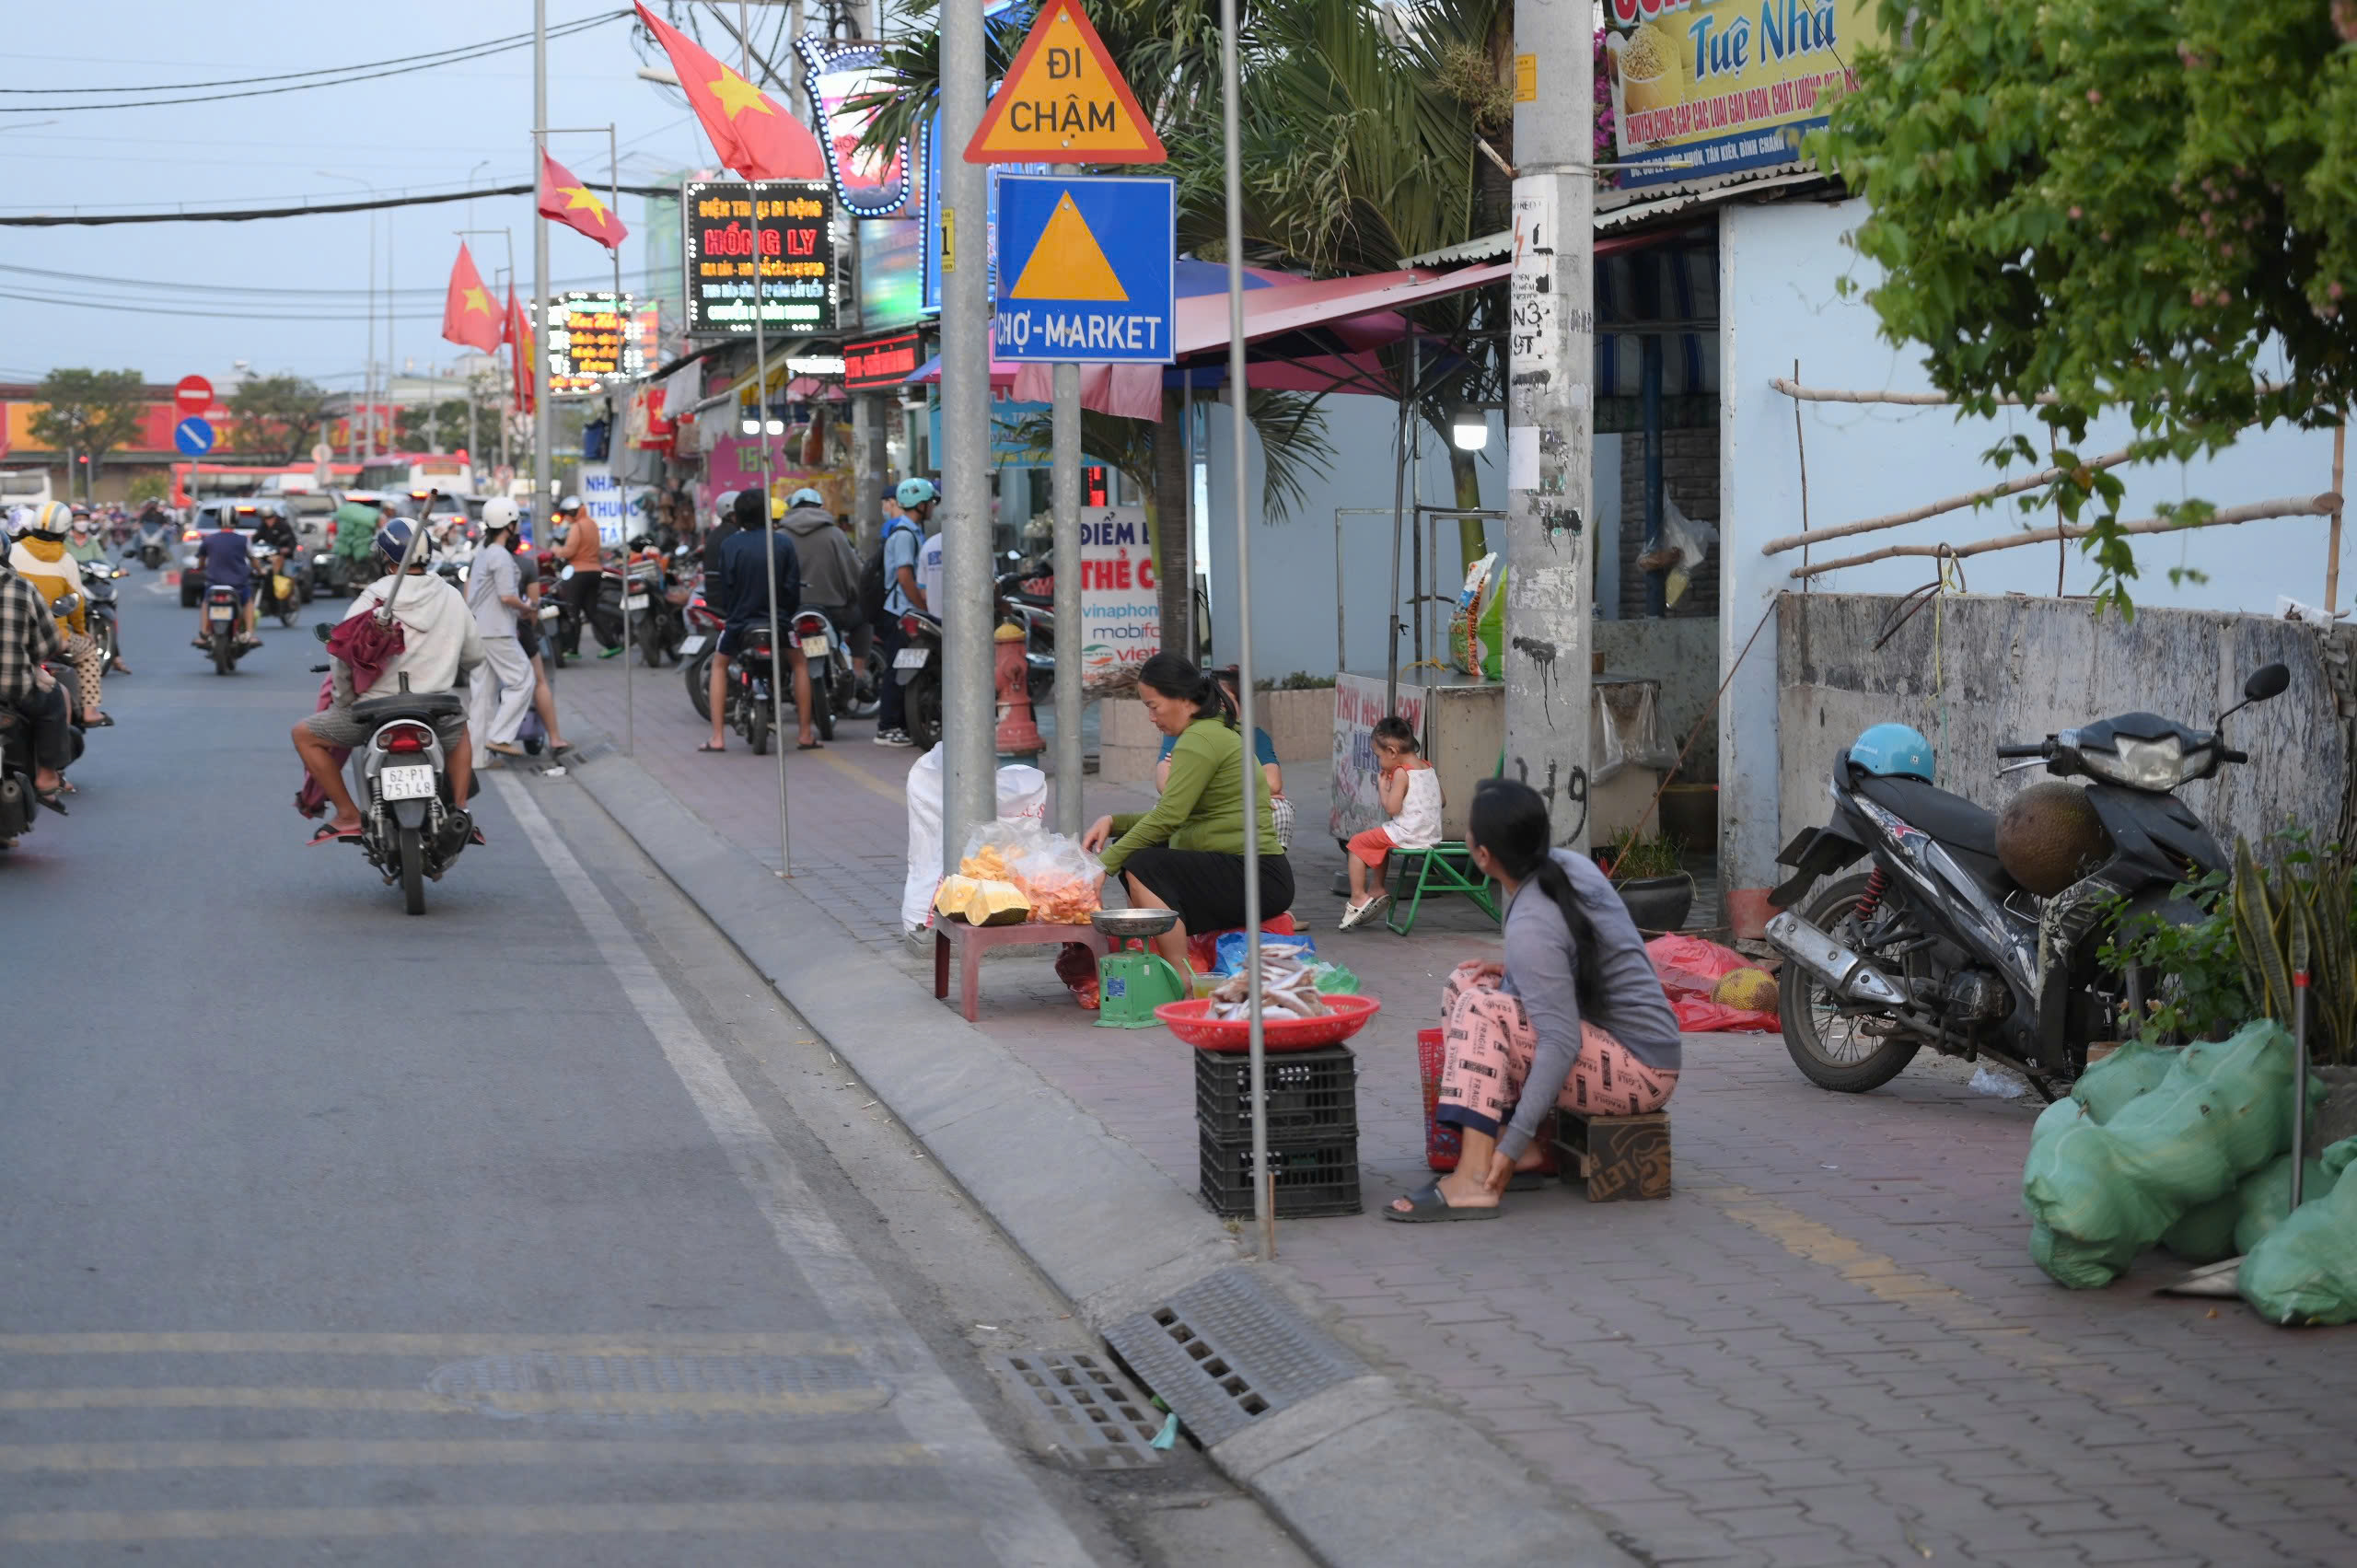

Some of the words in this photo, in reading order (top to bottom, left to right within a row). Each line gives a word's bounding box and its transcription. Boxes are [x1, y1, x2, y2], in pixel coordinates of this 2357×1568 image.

[1689, 14, 1751, 79] Tuệ
[1760, 0, 1836, 64] Nhã
[1047, 48, 1081, 79] ĐI
[1011, 93, 1115, 138] CHẬM
[1739, 138, 1758, 157] BÌNH
[1759, 134, 1784, 154] CHÁNH
[787, 228, 818, 255] LY
[1081, 547, 1132, 590] THẺ
[1083, 602, 1159, 619] vinaphon
[1093, 622, 1162, 639] mobifo
[1116, 645, 1161, 662] viet
[1472, 1078, 1481, 1108] FRAGIL
